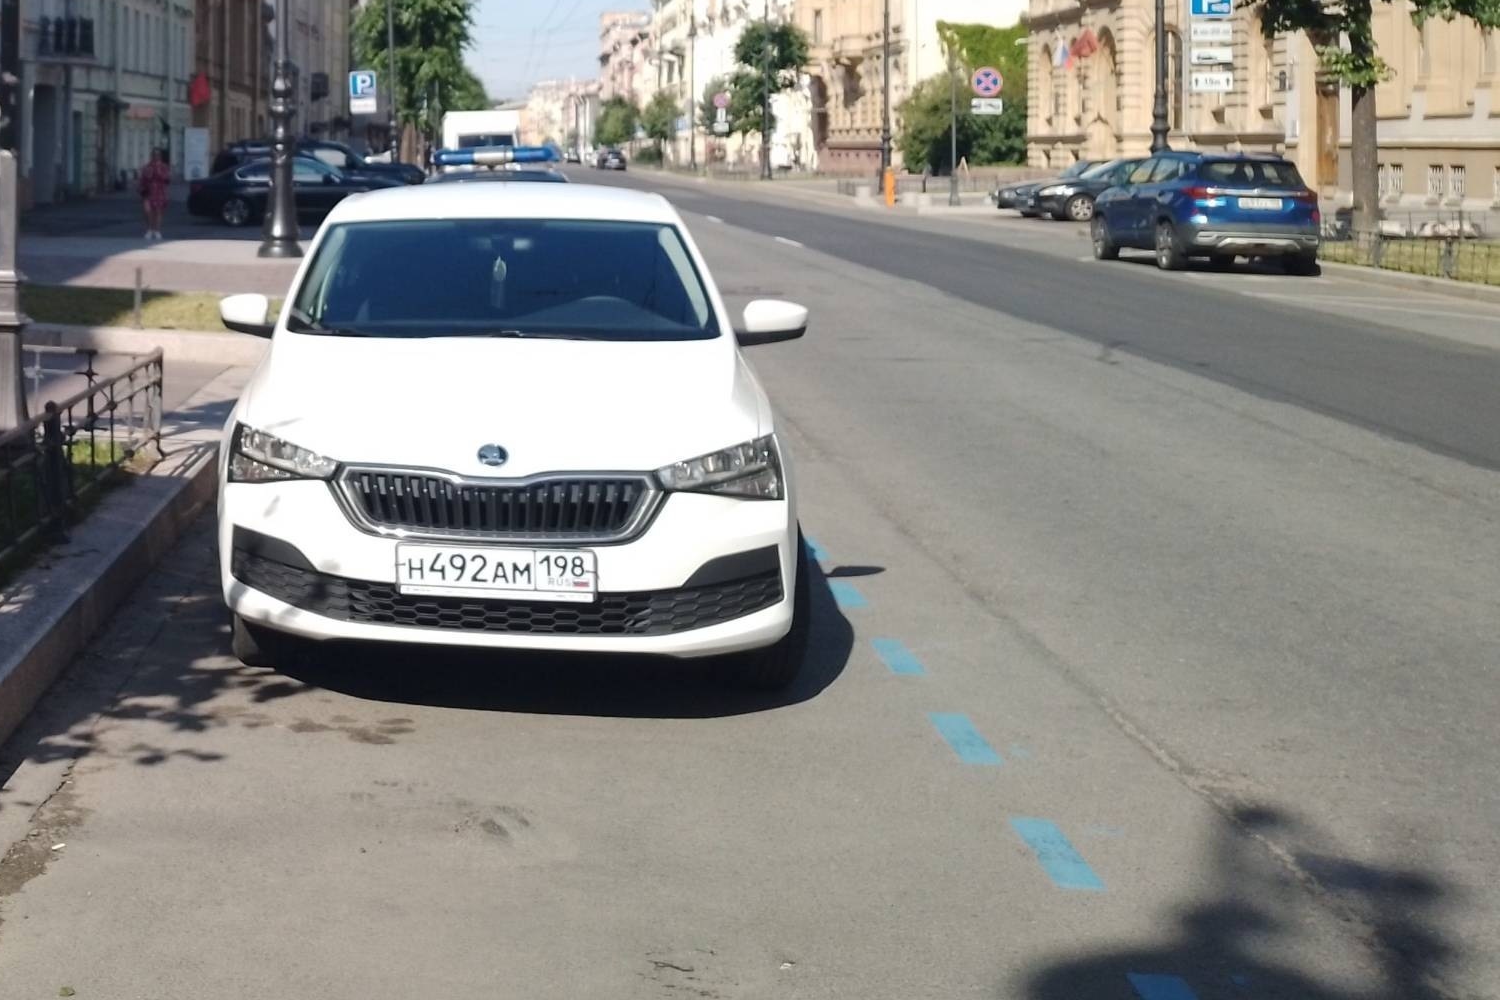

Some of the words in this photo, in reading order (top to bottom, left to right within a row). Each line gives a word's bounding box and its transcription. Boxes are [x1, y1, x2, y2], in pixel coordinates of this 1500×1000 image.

[408, 552, 532, 585] Н492АМ
[538, 555, 585, 578] 198
[547, 577, 572, 587] RUS
